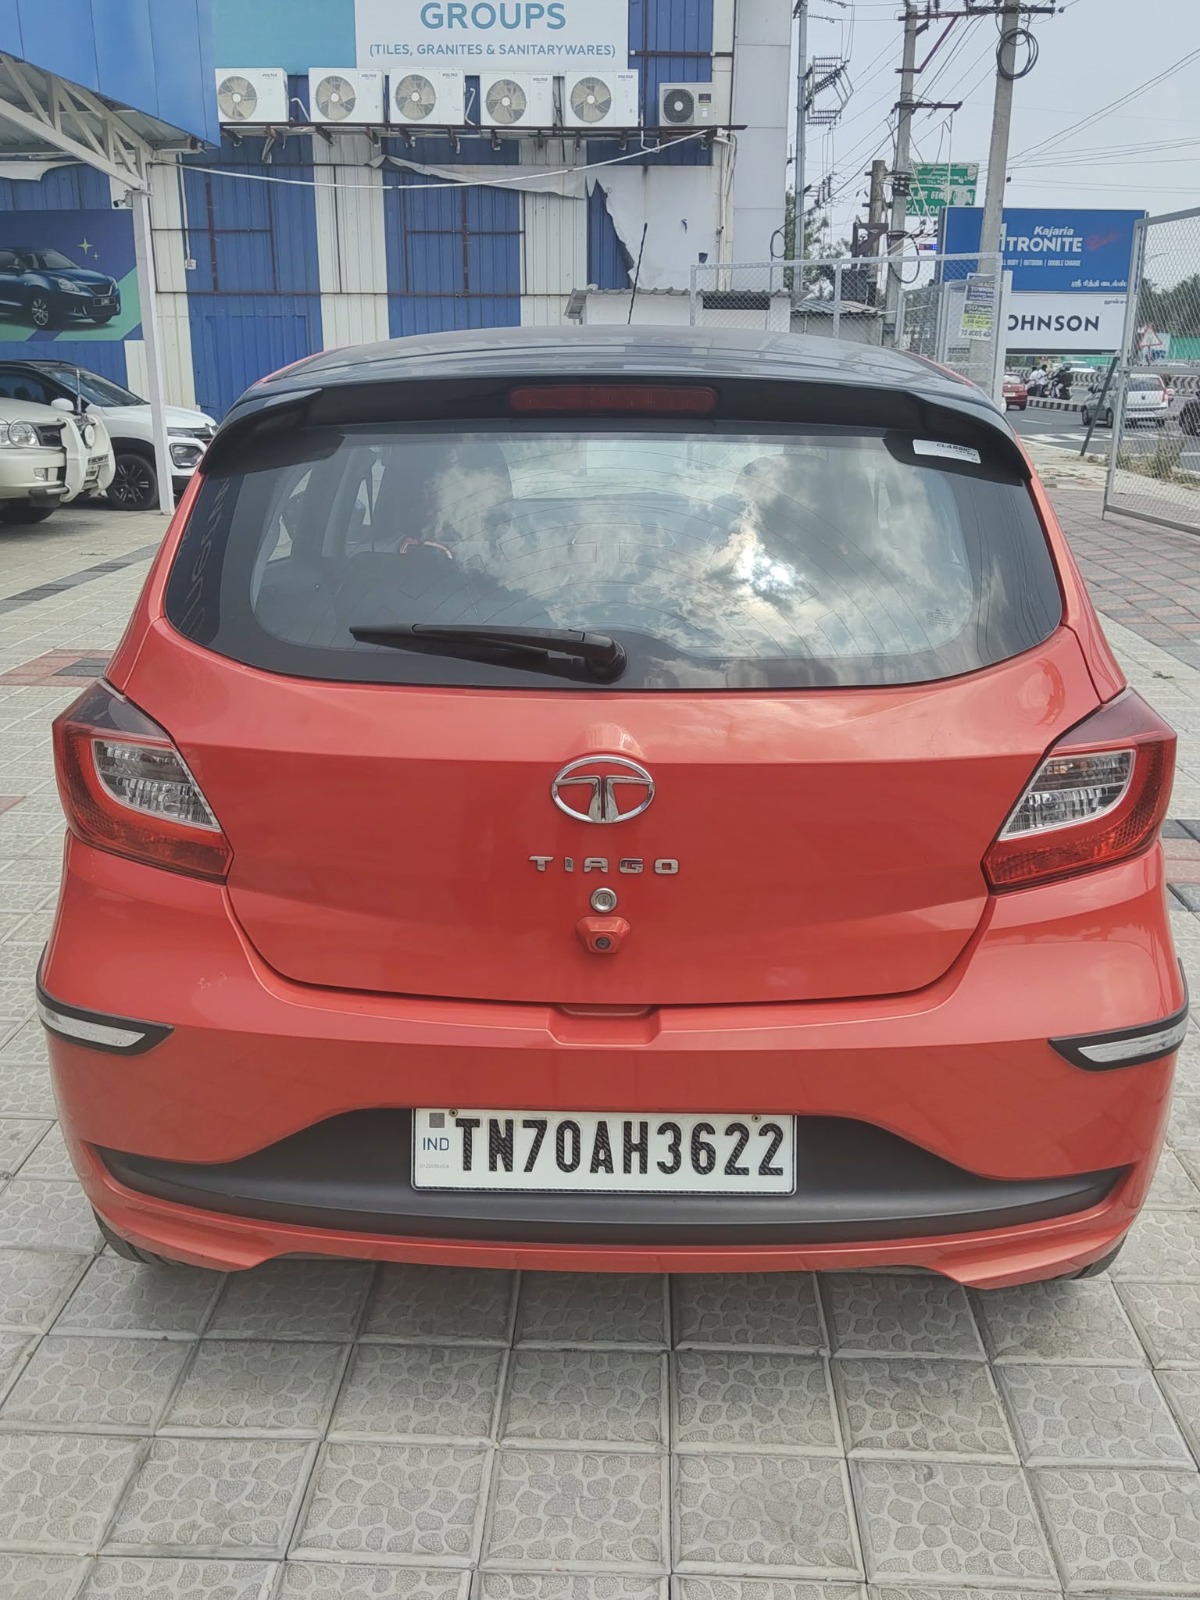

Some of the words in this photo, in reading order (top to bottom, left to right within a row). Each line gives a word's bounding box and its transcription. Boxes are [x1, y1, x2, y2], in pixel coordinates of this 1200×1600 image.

[420, 2, 566, 29] GROUPS
[369, 43, 413, 57] (TILES,
[416, 43, 483, 56] GRANITES
[486, 44, 495, 55] &
[499, 44, 616, 57] SANITARYWARES)
[1034, 226, 1074, 237] Kajaria
[528, 855, 679, 874] TIAGO
[423, 1137, 450, 1151] IND
[455, 1117, 784, 1176] TN70AH3622
